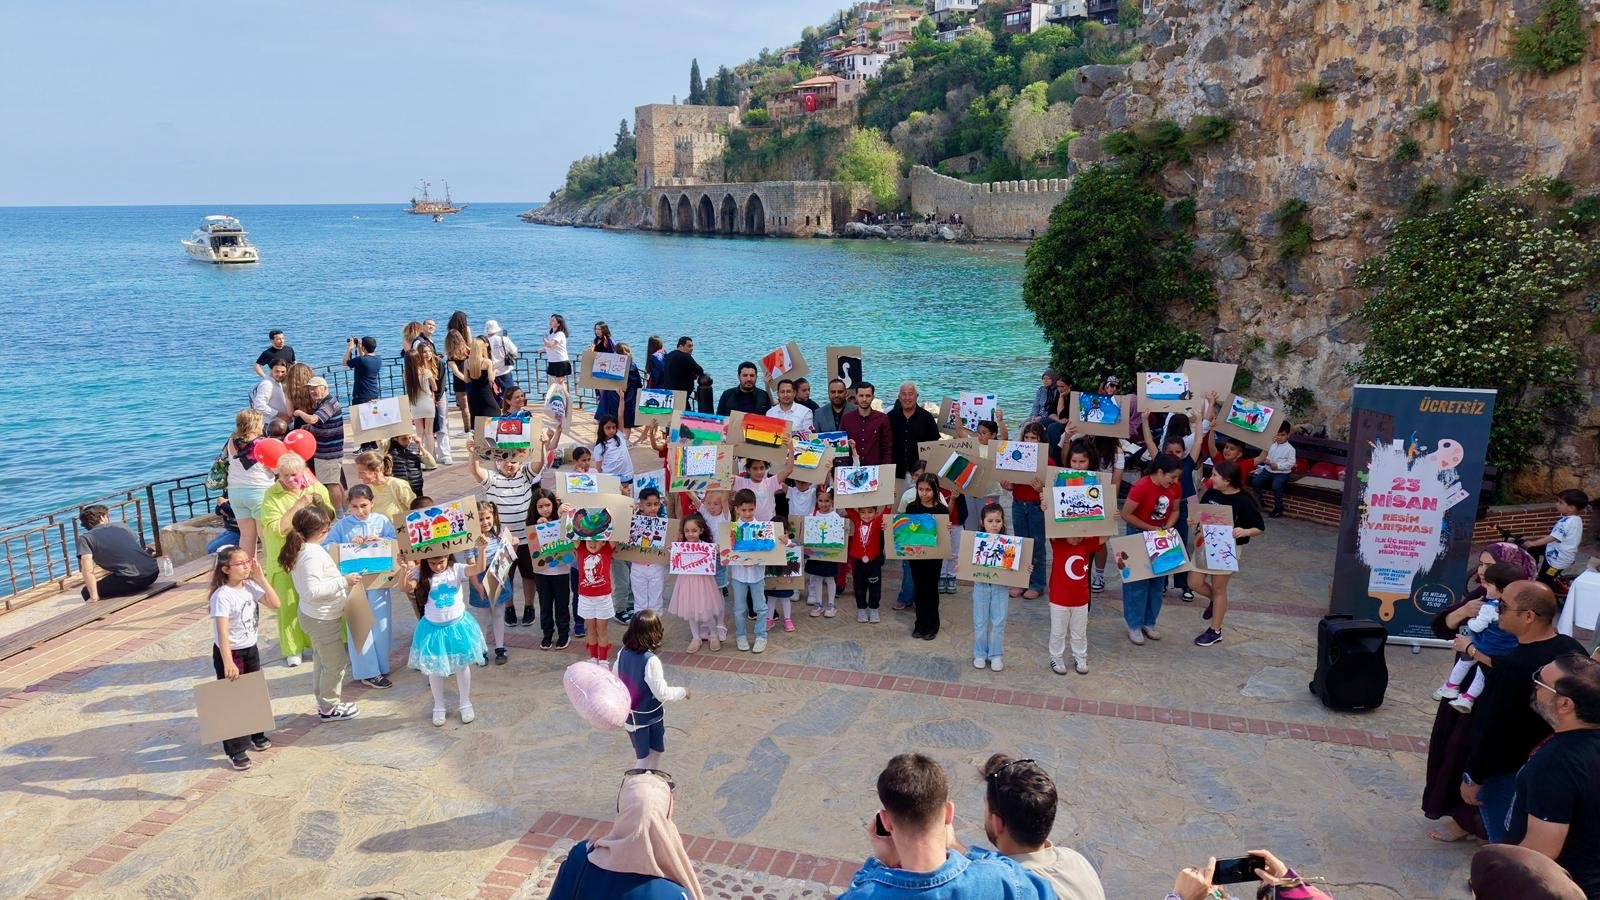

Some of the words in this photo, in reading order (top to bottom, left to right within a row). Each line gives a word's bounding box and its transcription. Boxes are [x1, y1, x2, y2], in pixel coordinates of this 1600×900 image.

[1419, 397, 1486, 415] ÜCRETSİZ
[1391, 477, 1420, 492] 23
[1370, 491, 1438, 511] NİSAN
[1382, 513, 1420, 524] RESİM
[1367, 522, 1434, 535] YARIŞMASI
